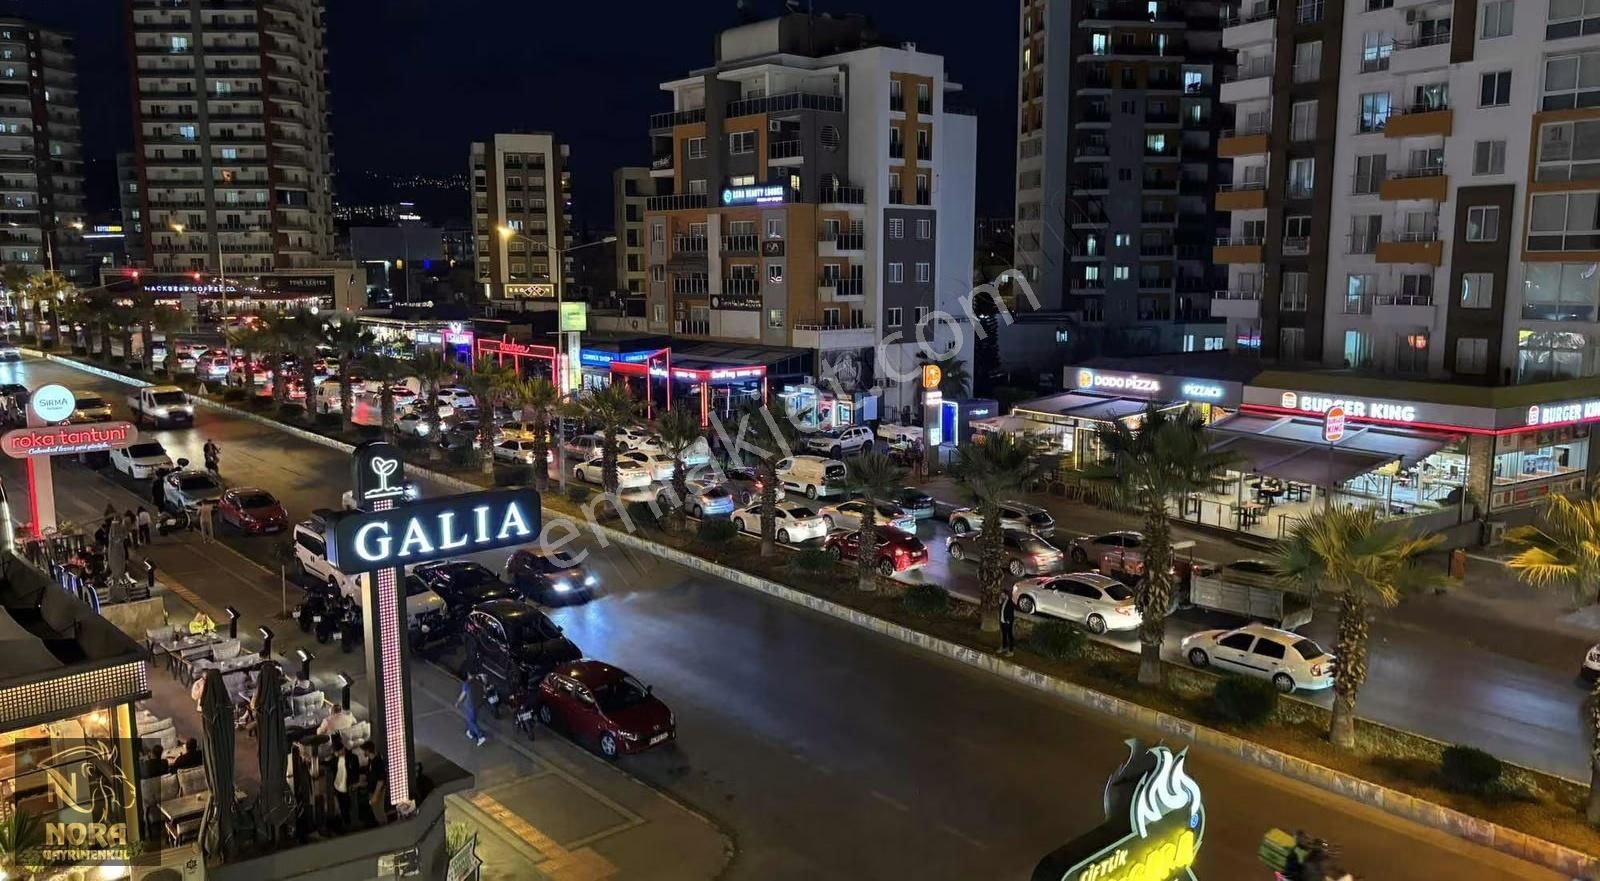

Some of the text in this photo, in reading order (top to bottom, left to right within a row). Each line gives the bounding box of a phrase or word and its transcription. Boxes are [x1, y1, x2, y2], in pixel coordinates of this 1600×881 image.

[1095, 375, 1125, 388] DODO
[1300, 395, 1415, 421] BURGER KING
[1542, 404, 1581, 424] BURGER
[12, 426, 125, 448] roka tantuni
[355, 502, 530, 561] GALIA
